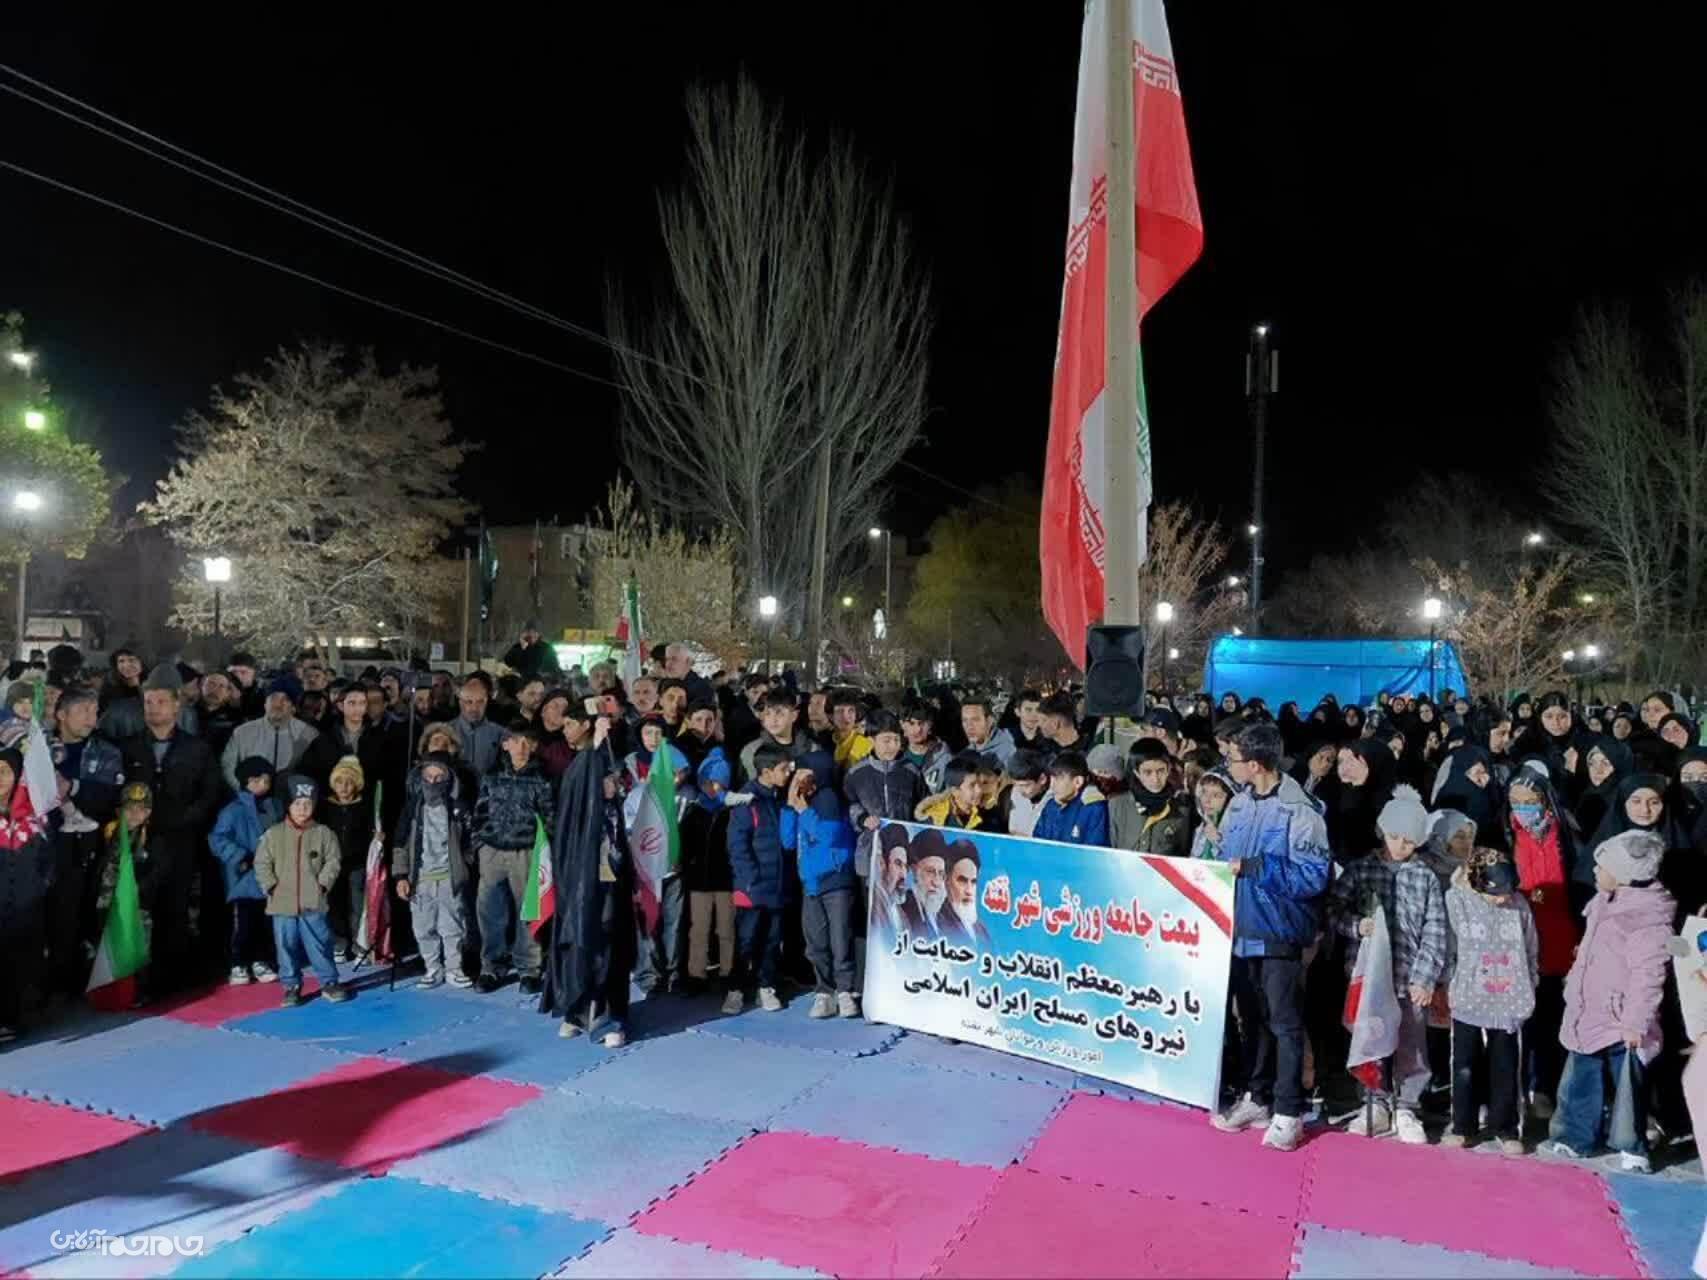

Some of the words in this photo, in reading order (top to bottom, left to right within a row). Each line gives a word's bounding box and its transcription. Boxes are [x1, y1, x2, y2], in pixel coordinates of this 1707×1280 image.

[1013, 882, 1041, 928] شهر
[1043, 886, 1102, 942] ورزشی
[1106, 897, 1153, 949] جامعه
[1158, 911, 1200, 958] بیعت
[894, 933, 908, 955] از
[912, 938, 975, 962] حمایت
[981, 956, 992, 973] و
[998, 953, 1060, 981] انقلاب
[903, 971, 970, 998] اسلامی
[1066, 966, 1124, 996] معظم
[976, 986, 1027, 1015] ایران
[1033, 999, 1089, 1025] مسلح
[1184, 990, 1200, 1021] با
[1095, 1012, 1186, 1056] نیروهای
